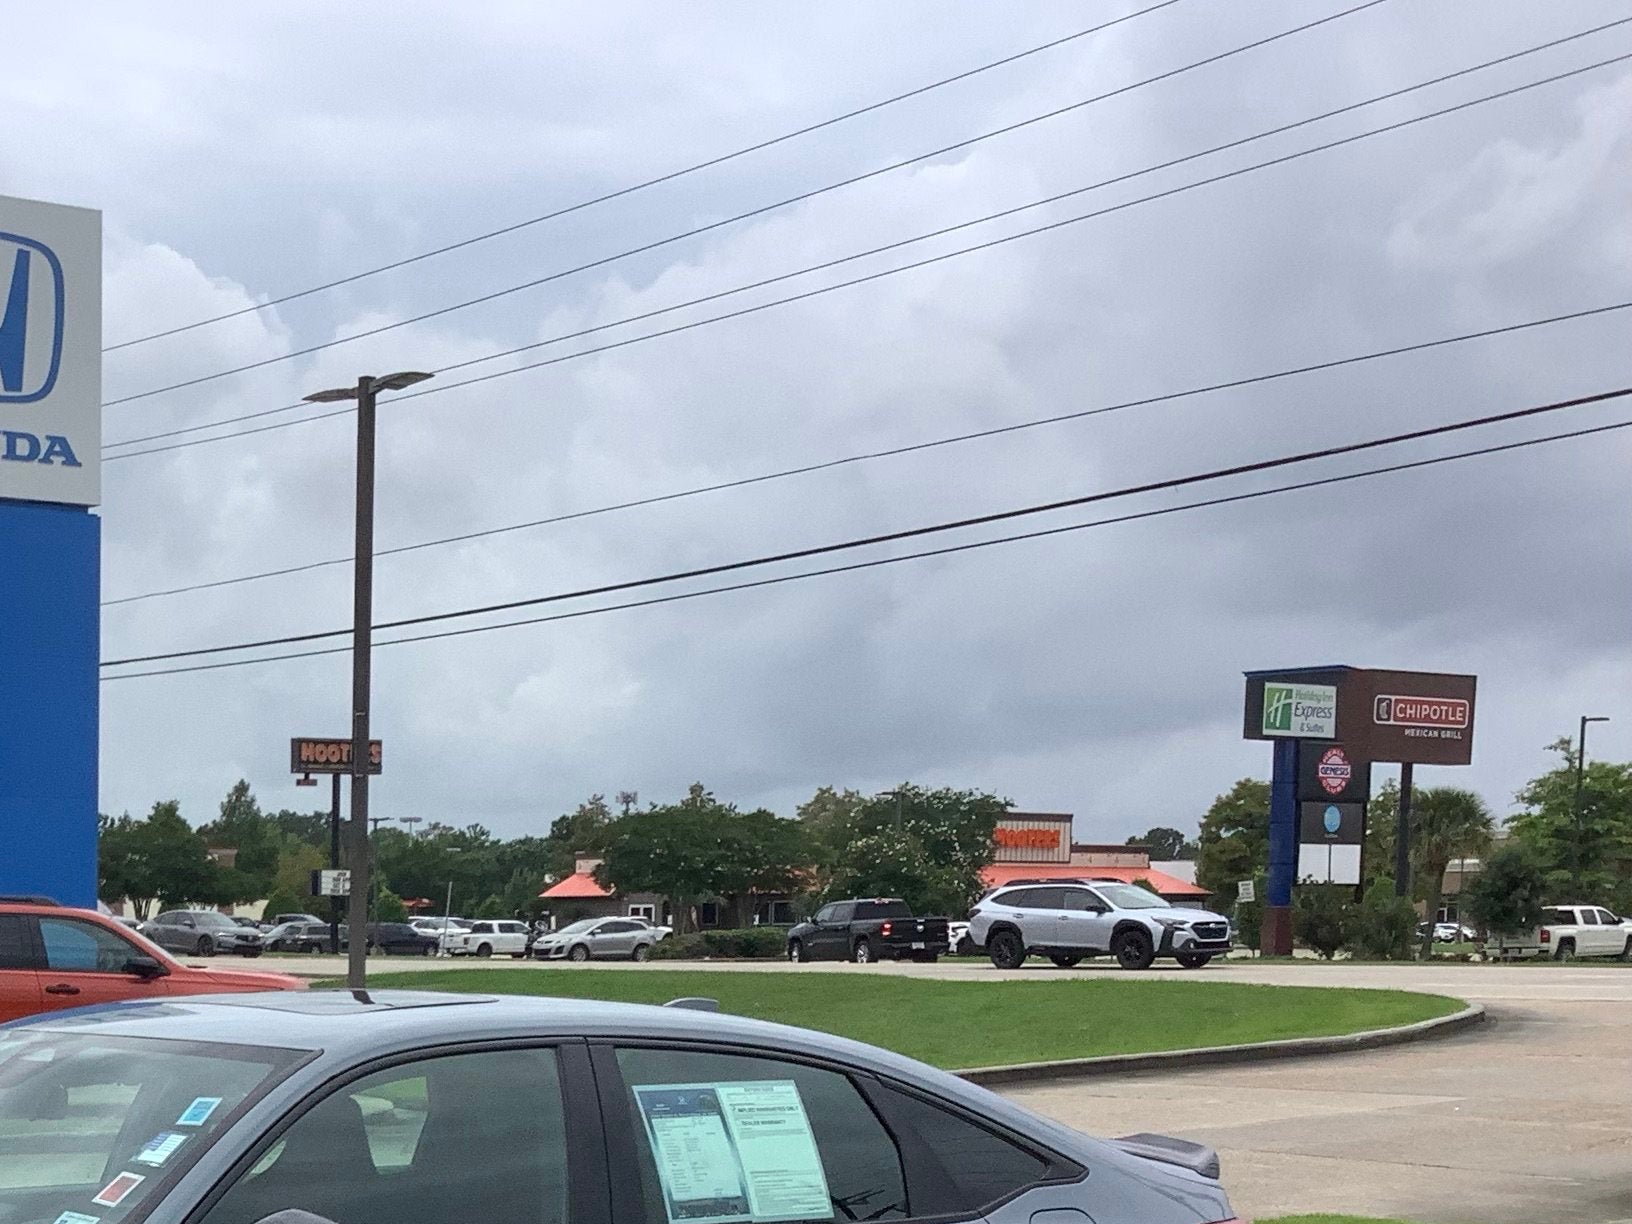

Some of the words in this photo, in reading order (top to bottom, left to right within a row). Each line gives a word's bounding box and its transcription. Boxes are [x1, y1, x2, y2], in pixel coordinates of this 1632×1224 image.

[1295, 702, 1333, 721] Express
[1396, 704, 1465, 721] CHIPOTLE
[1405, 729, 1439, 738] MEXICAN
[1441, 731, 1462, 739] GRILL
[300, 742, 381, 764] HOOTS
[1320, 767, 1349, 776] GENESIS
